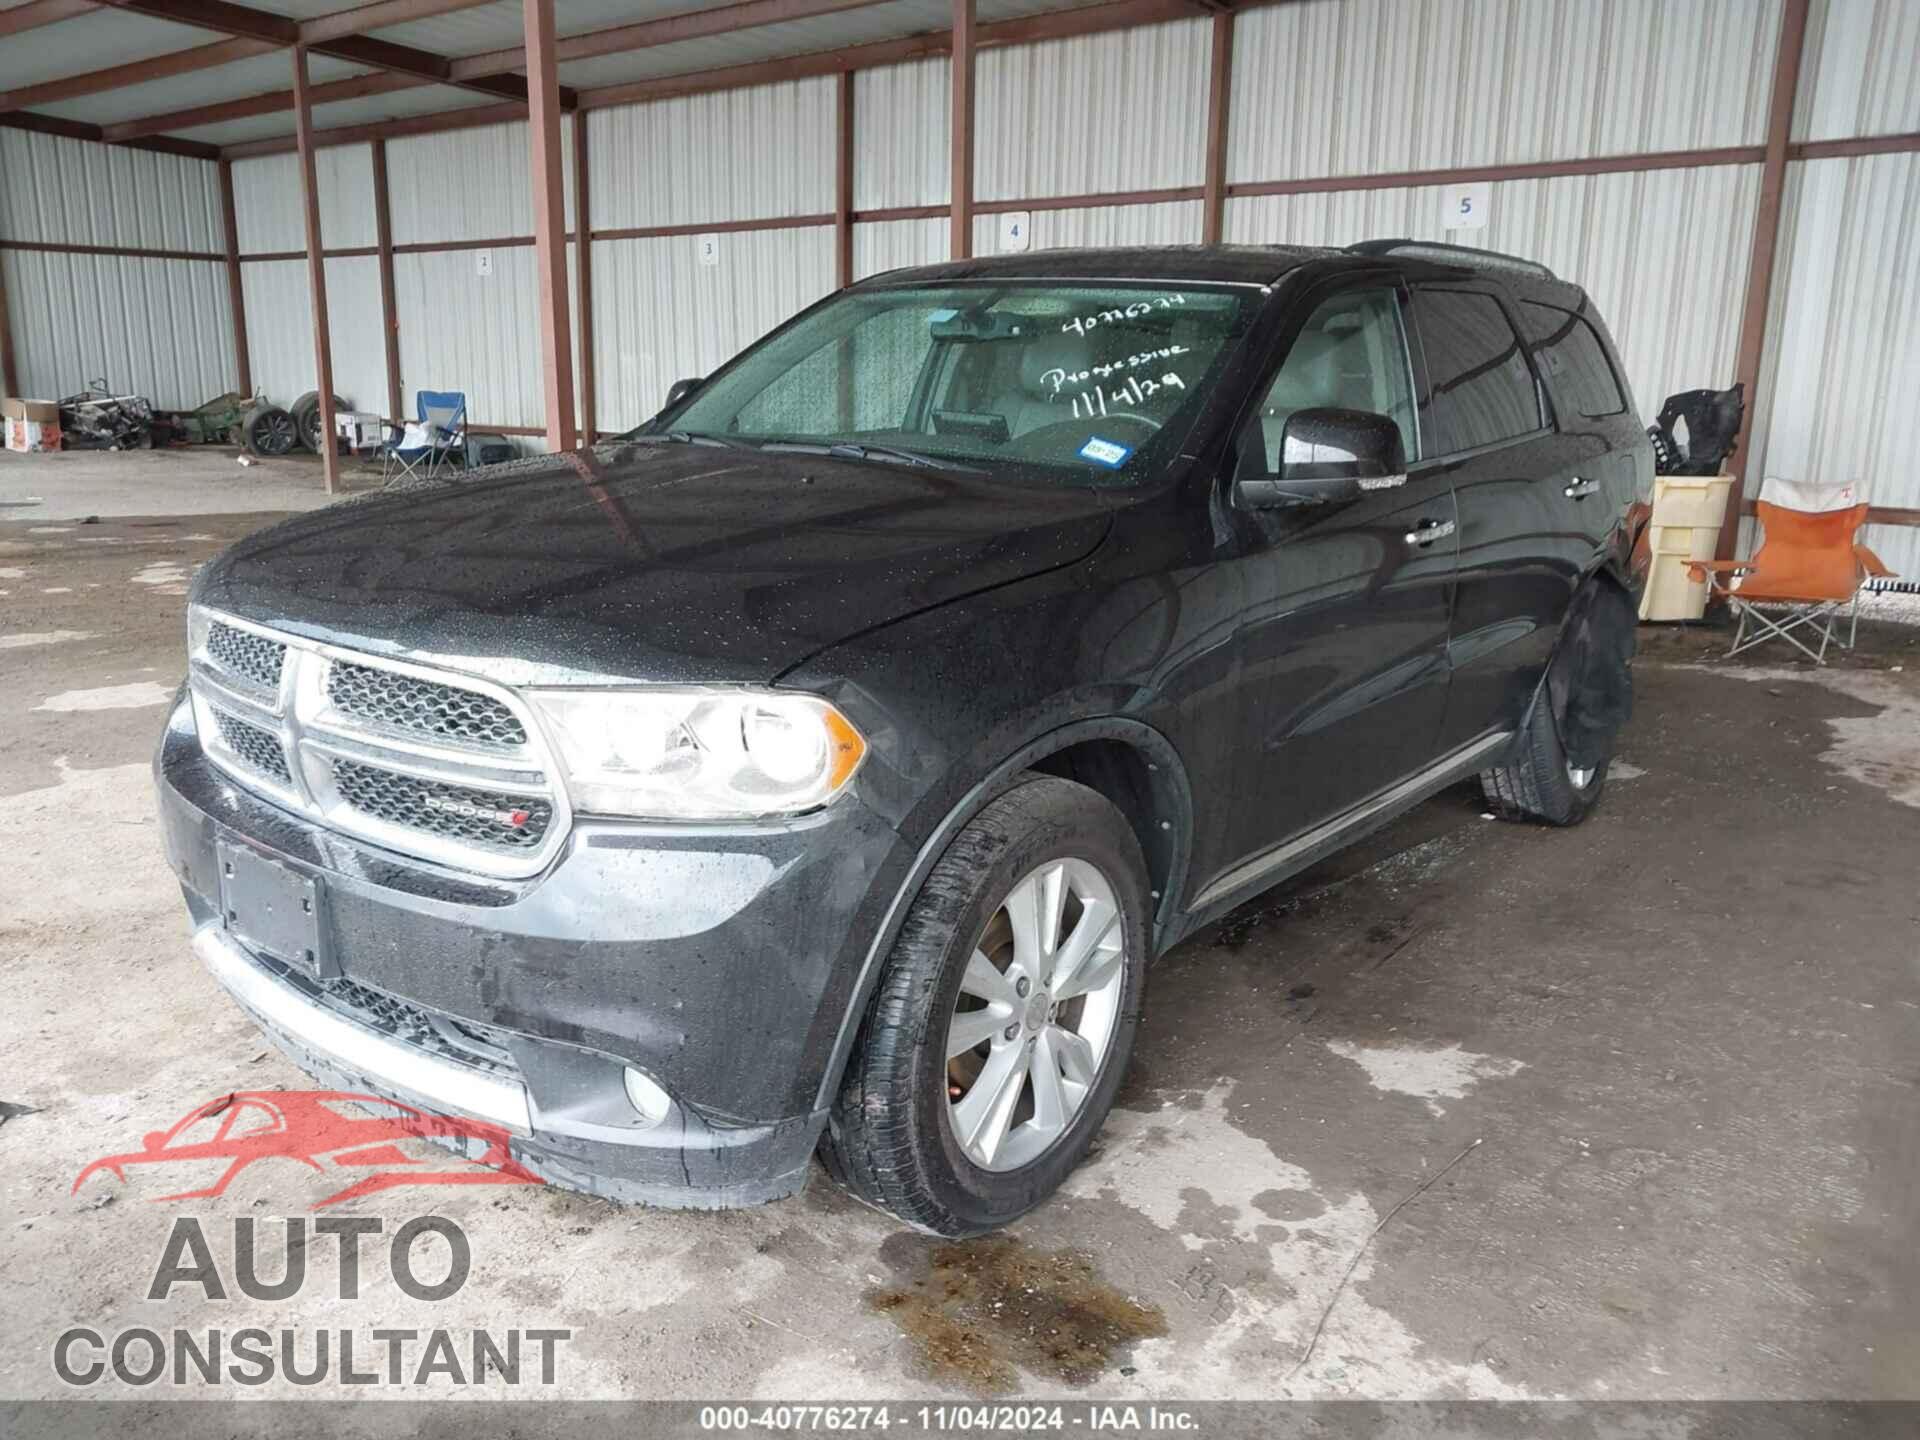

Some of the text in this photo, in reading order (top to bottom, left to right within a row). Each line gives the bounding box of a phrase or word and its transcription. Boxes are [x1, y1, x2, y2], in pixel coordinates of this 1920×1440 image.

[1460, 197, 1472, 214] 5
[1010, 223, 1019, 237] 4
[705, 242, 713, 255] 3
[1062, 294, 1186, 337] 40776274
